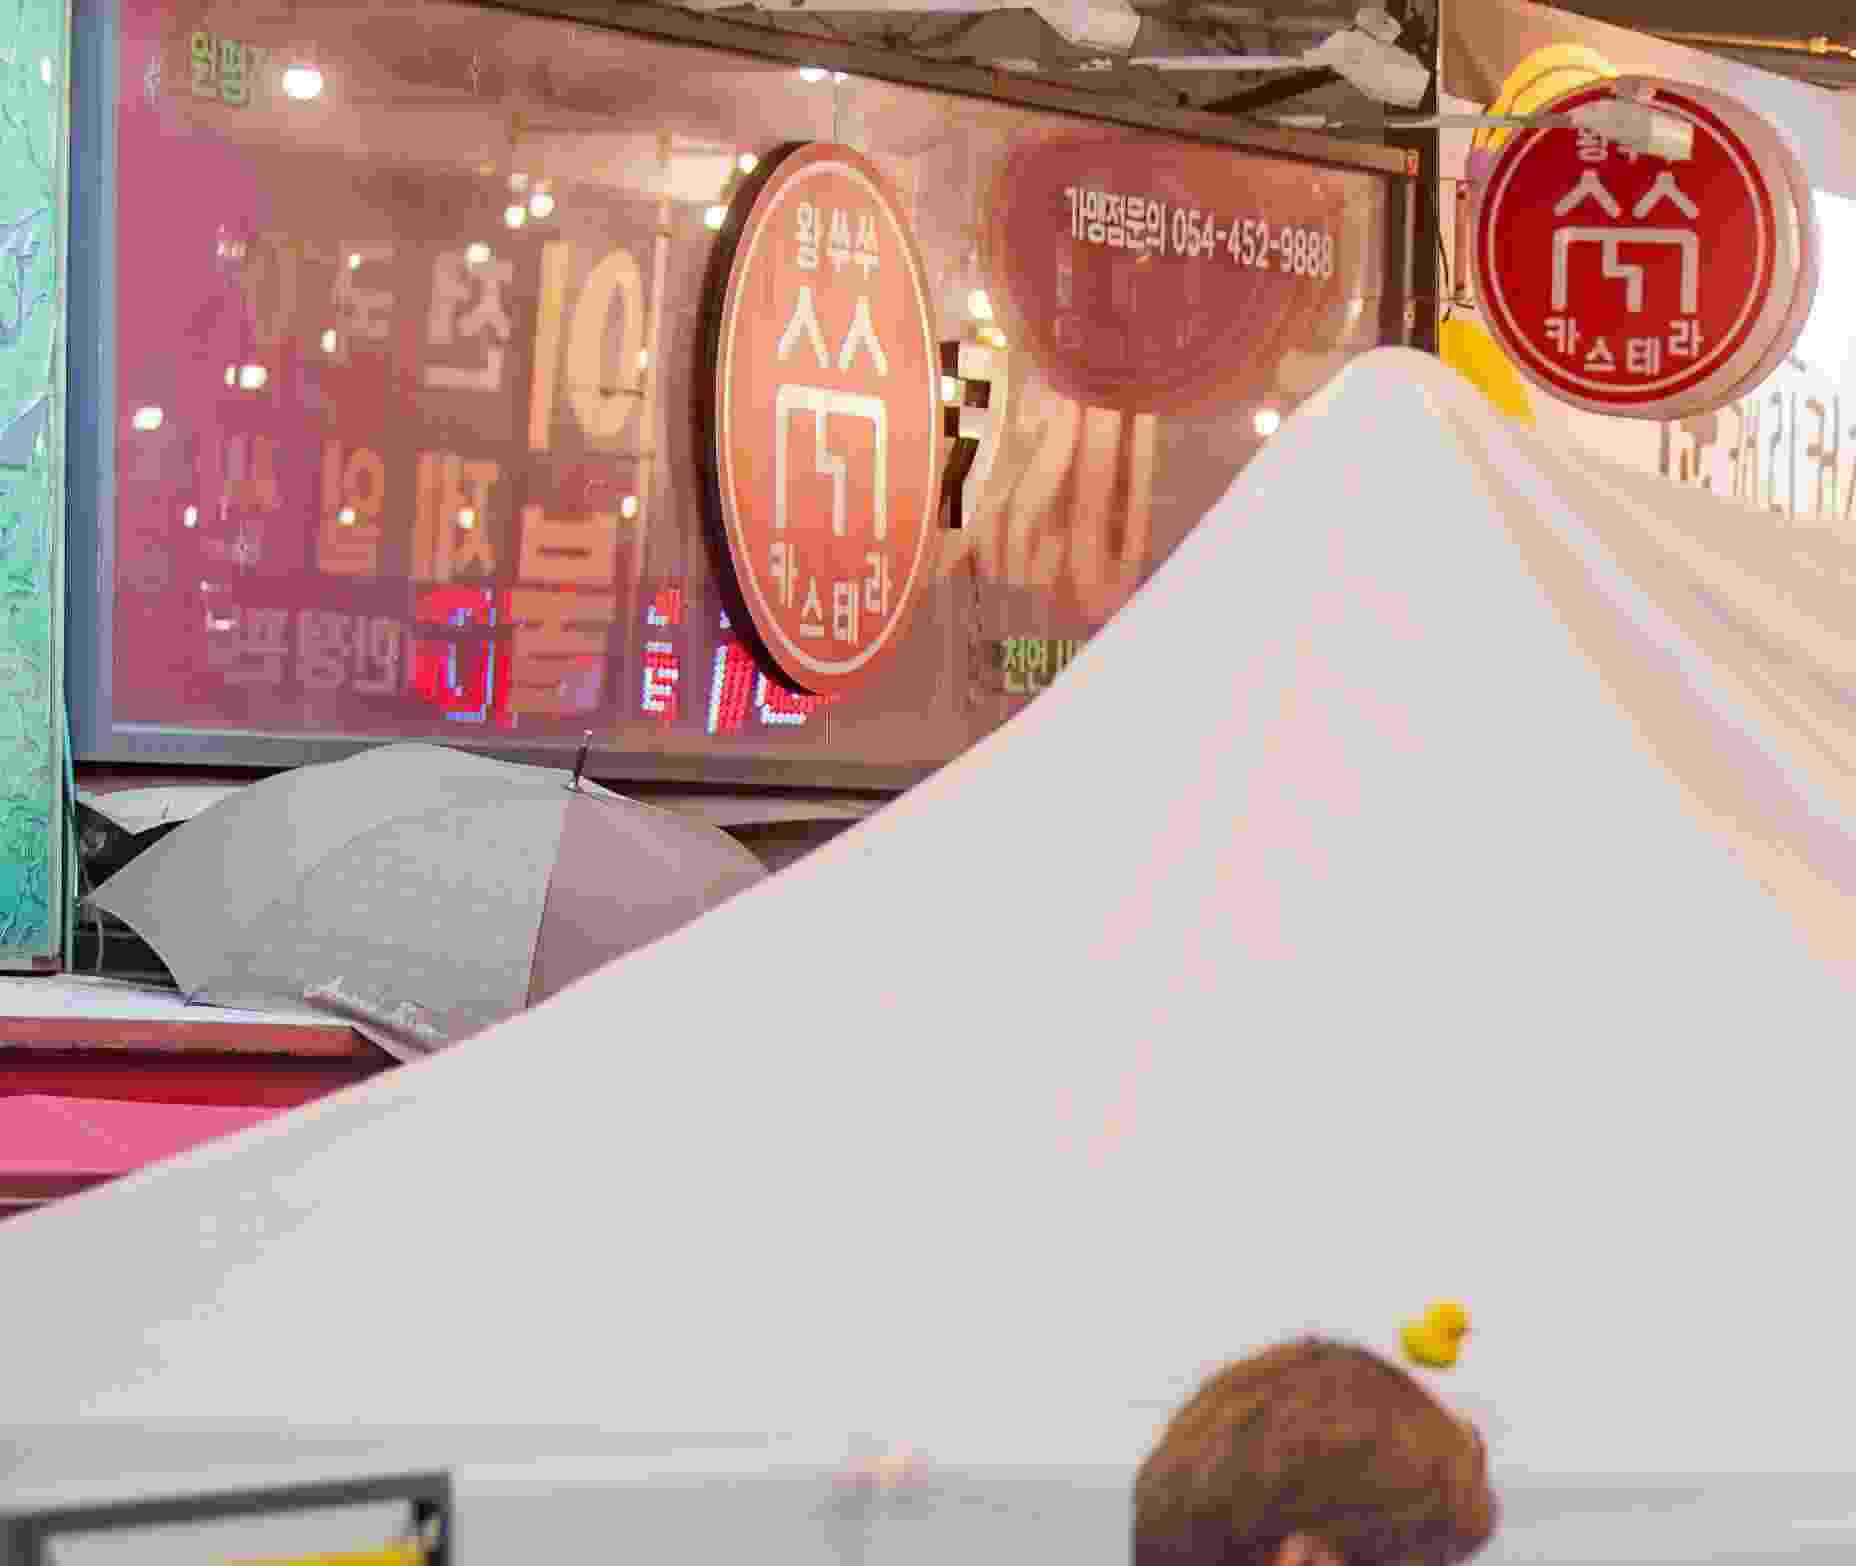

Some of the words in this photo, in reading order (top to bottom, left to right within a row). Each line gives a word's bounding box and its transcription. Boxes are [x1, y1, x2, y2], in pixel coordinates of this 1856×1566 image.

[1064, 185, 1167, 255] 가맹점문의
[1544, 315, 1704, 377] 카스테라
[768, 537, 892, 648] 카스테라
